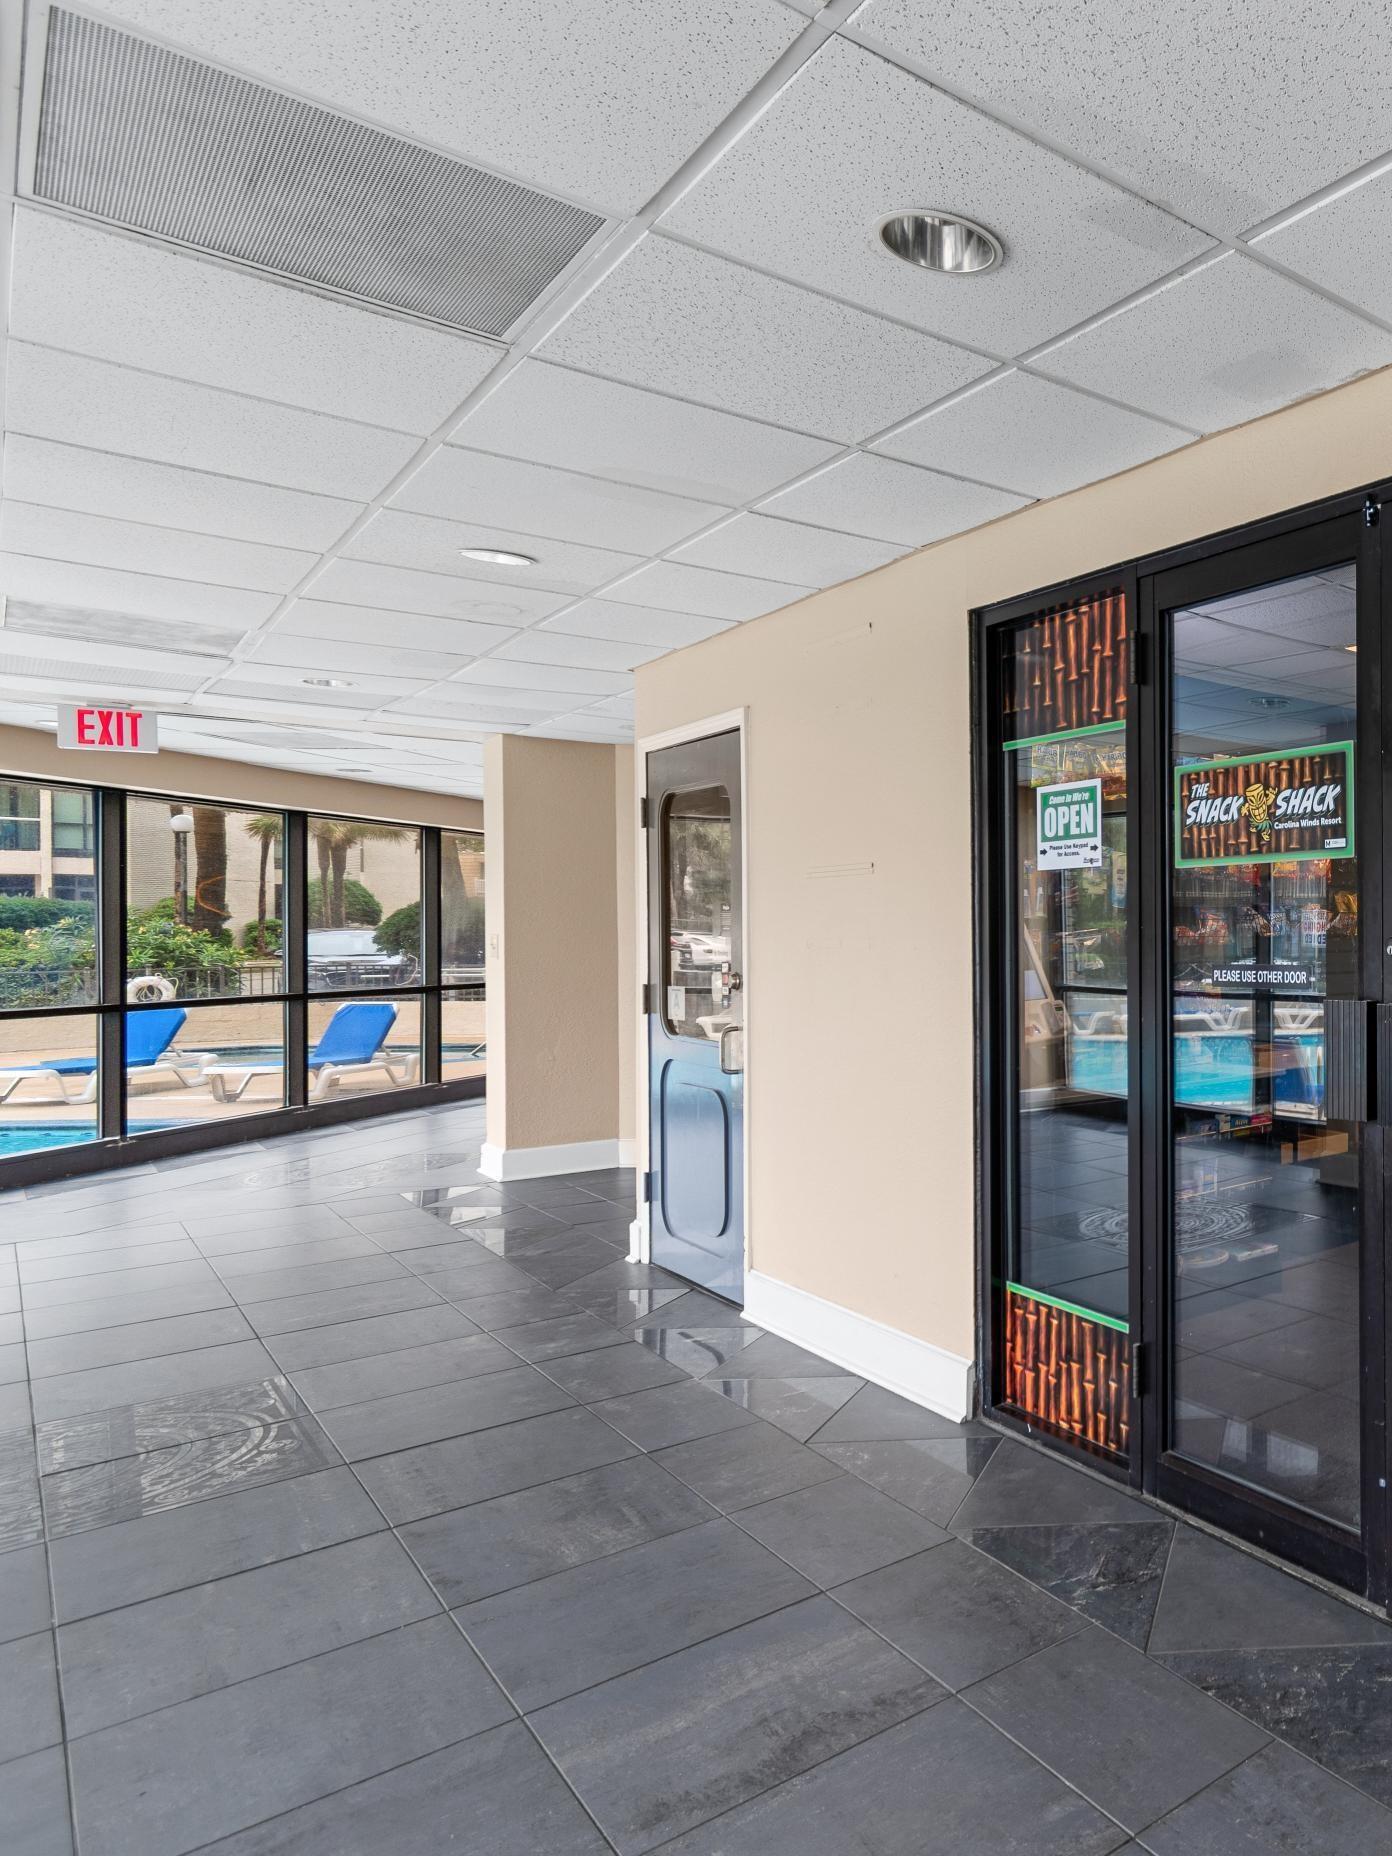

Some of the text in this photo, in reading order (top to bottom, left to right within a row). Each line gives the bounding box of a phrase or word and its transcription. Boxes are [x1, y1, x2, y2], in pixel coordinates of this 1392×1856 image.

[77, 709, 142, 747] EXIT
[1191, 782, 1209, 799] THE
[1185, 784, 1341, 825] SNACK SHACK
[1044, 803, 1094, 837] OPEN
[1274, 816, 1342, 829] Carolina Winds Resort
[1073, 842, 1088, 850] Keypad
[1213, 969, 1307, 984] PLEASE USE OTHER DOOR
